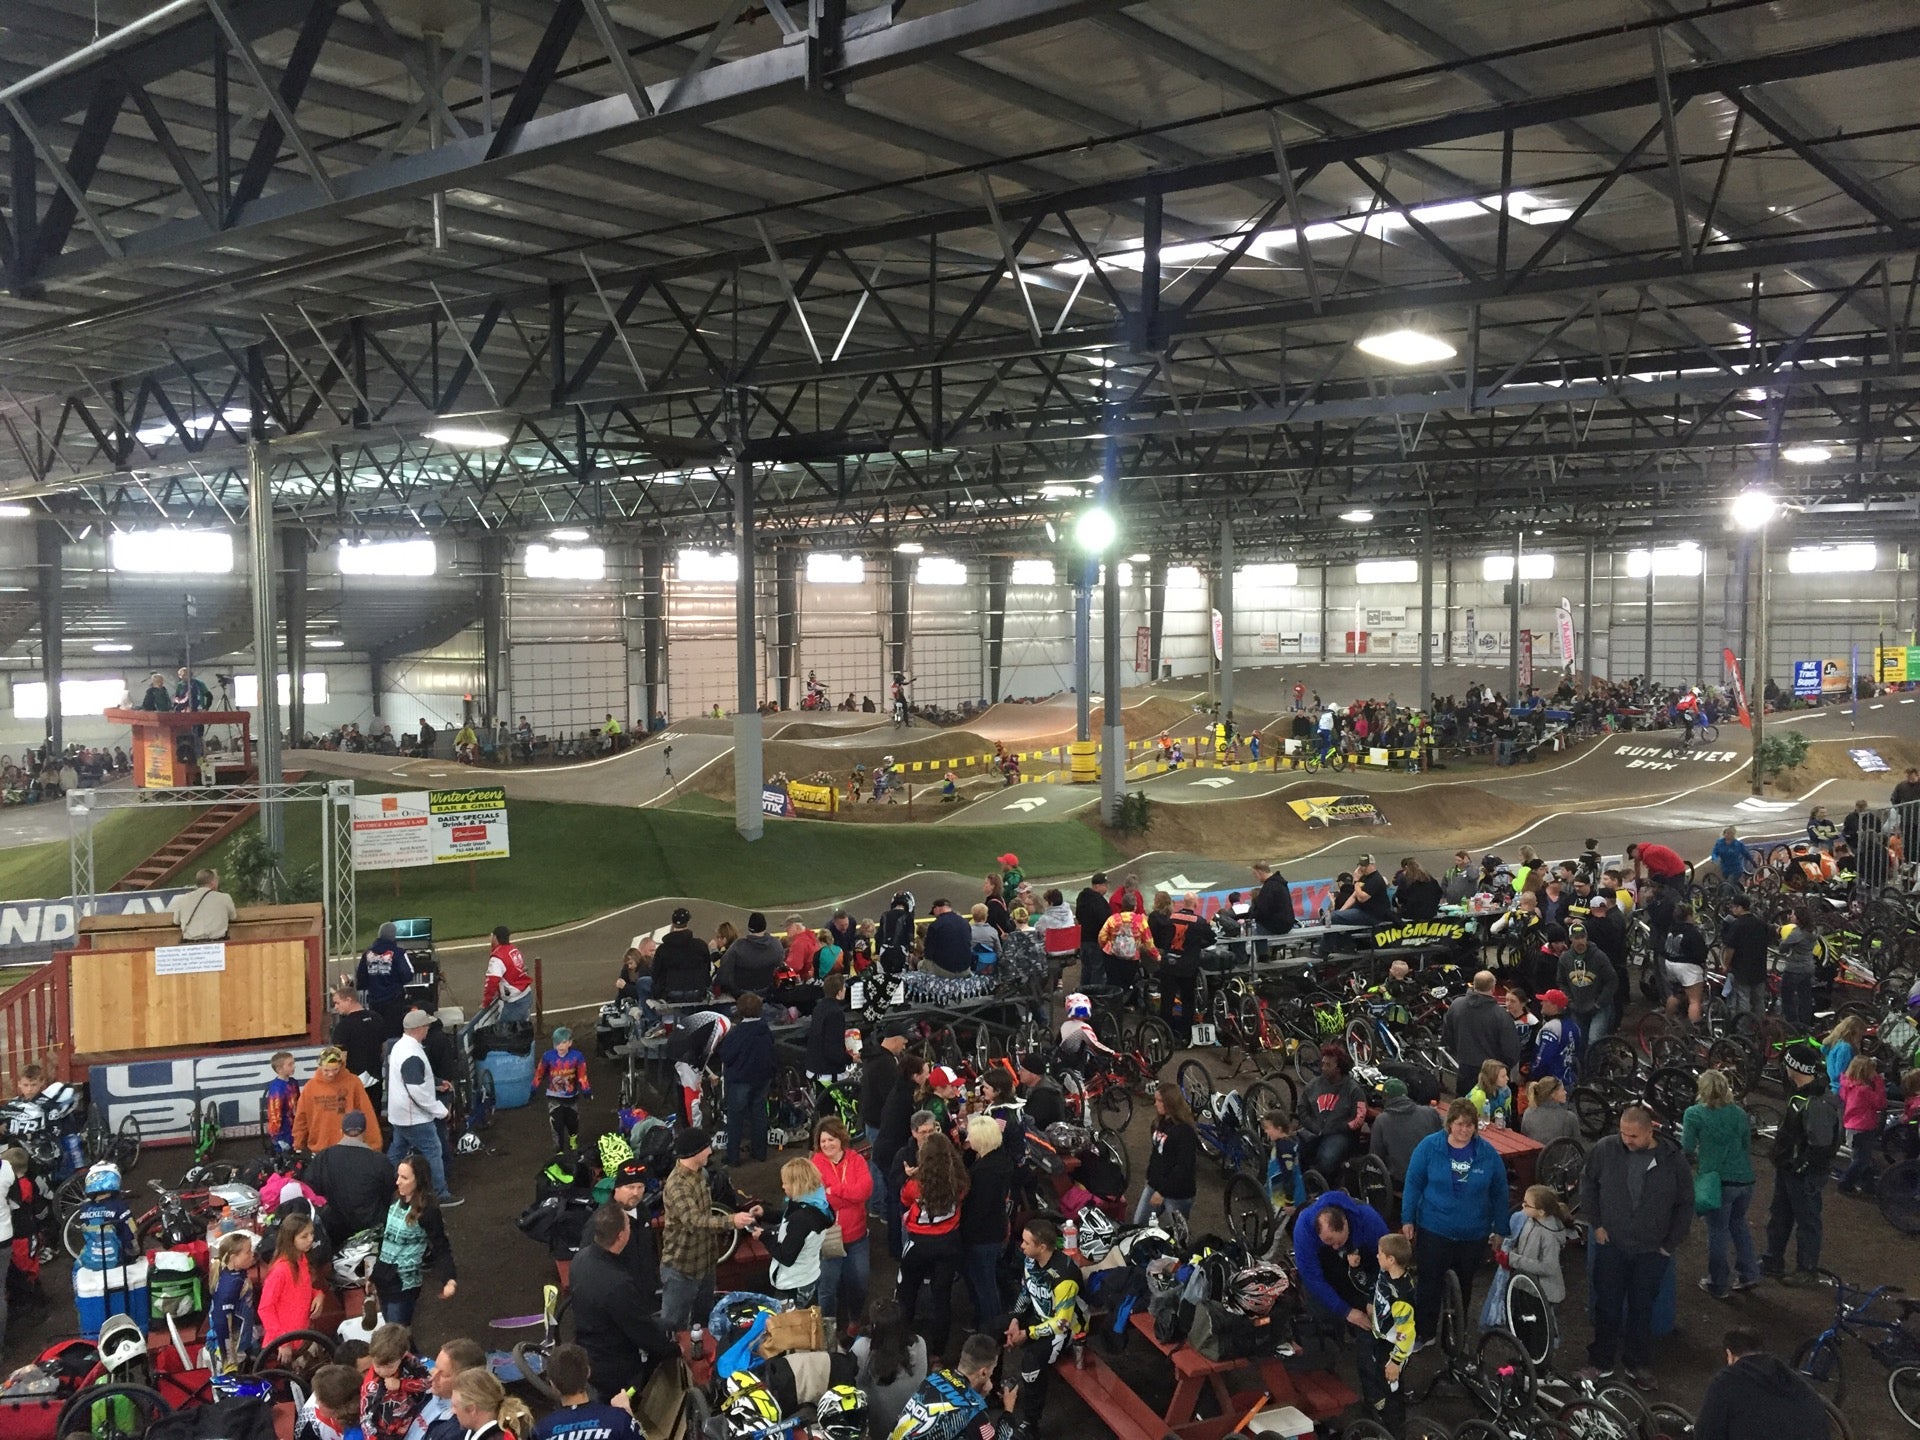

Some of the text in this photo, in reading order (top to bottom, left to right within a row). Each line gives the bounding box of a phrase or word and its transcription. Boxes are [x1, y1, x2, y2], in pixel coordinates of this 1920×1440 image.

[1799, 670, 1818, 678] Track
[1797, 678, 1820, 688] Supply
[1614, 745, 1662, 759] RUM
[1625, 759, 1679, 772] BMX
[438, 812, 500, 823] DAILY SPECIALS
[1375, 922, 1465, 947] DINGMAN'S
